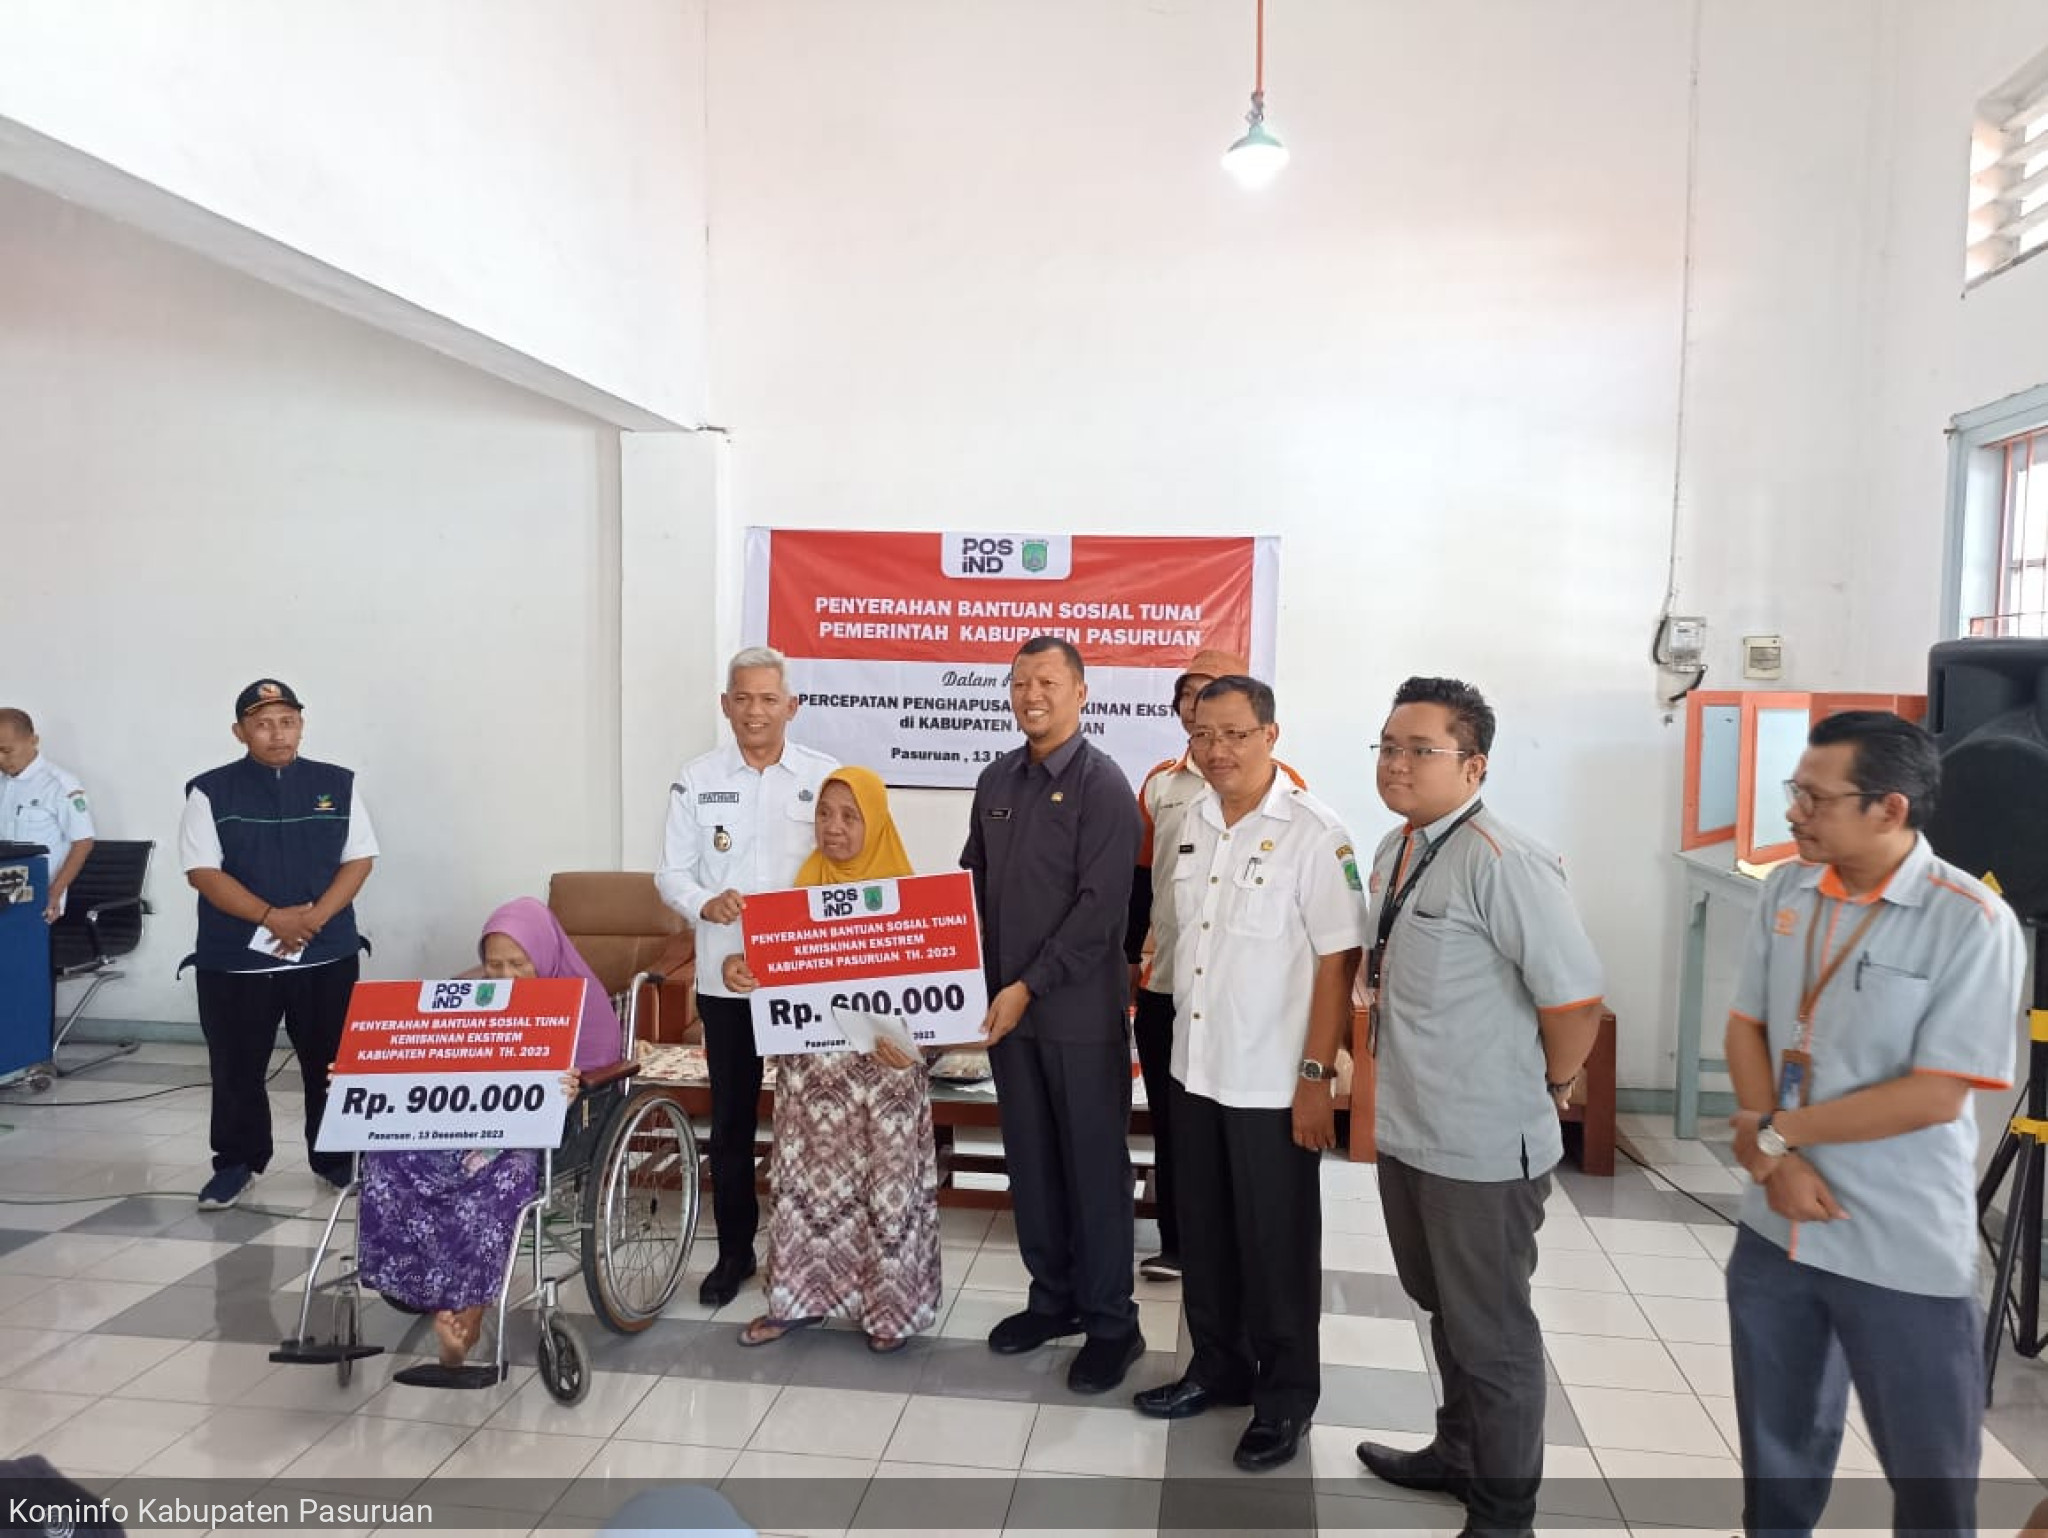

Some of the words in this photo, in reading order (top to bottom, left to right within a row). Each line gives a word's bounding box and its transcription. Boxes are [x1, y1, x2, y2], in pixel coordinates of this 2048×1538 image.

[963, 538, 1013, 555] POS
[815, 597, 951, 616] PENYERAHAN
[958, 601, 1052, 618] BANTUAN
[1058, 603, 1134, 620] SOSIAL
[1139, 604, 1201, 621] TUNAI
[820, 622, 948, 640] PEMERINTAH
[960, 626, 1079, 643] KABUPATEN
[1086, 628, 1201, 646] PASURUAN
[942, 671, 996, 687] Dalam
[798, 694, 898, 709] PERCEPATAN
[903, 698, 1011, 712] PENGHAPUSA
[900, 717, 914, 729] di
[919, 718, 1012, 732] KABUPATEN
[892, 748, 960, 762] Pasuruan
[972, 750, 990, 763] 13
[822, 888, 858, 903] POS
[751, 929, 827, 945] PENYERAHAN
[830, 922, 884, 936] BANTUAN
[886, 917, 929, 931] SOSIAL
[932, 914, 967, 927] TUNAI
[794, 940, 867, 956] KEMISKINAN
[869, 934, 924, 948] EKSTREM
[768, 958, 833, 973] KABUPATEN
[837, 952, 900, 967] PASURUAN
[926, 946, 956, 959] 2023
[435, 982, 471, 995] POS
[769, 998, 822, 1030] Rp.
[351, 1018, 429, 1031] PENYERAHAN
[432, 1018, 486, 1029] BANTUAN
[489, 1016, 531, 1028] SOSIAL
[535, 1016, 569, 1027] TUNAI
[390, 1033, 465, 1045] KEMISKINAN
[467, 1032, 523, 1043] EKSTREM
[357, 1049, 426, 1061] KABUPATEN
[429, 1048, 493, 1059] PASURUAN
[500, 1047, 517, 1058] TH.
[519, 1046, 550, 1057] 2023
[342, 1087, 394, 1120] Rp.
[407, 1084, 545, 1113] 900.000
